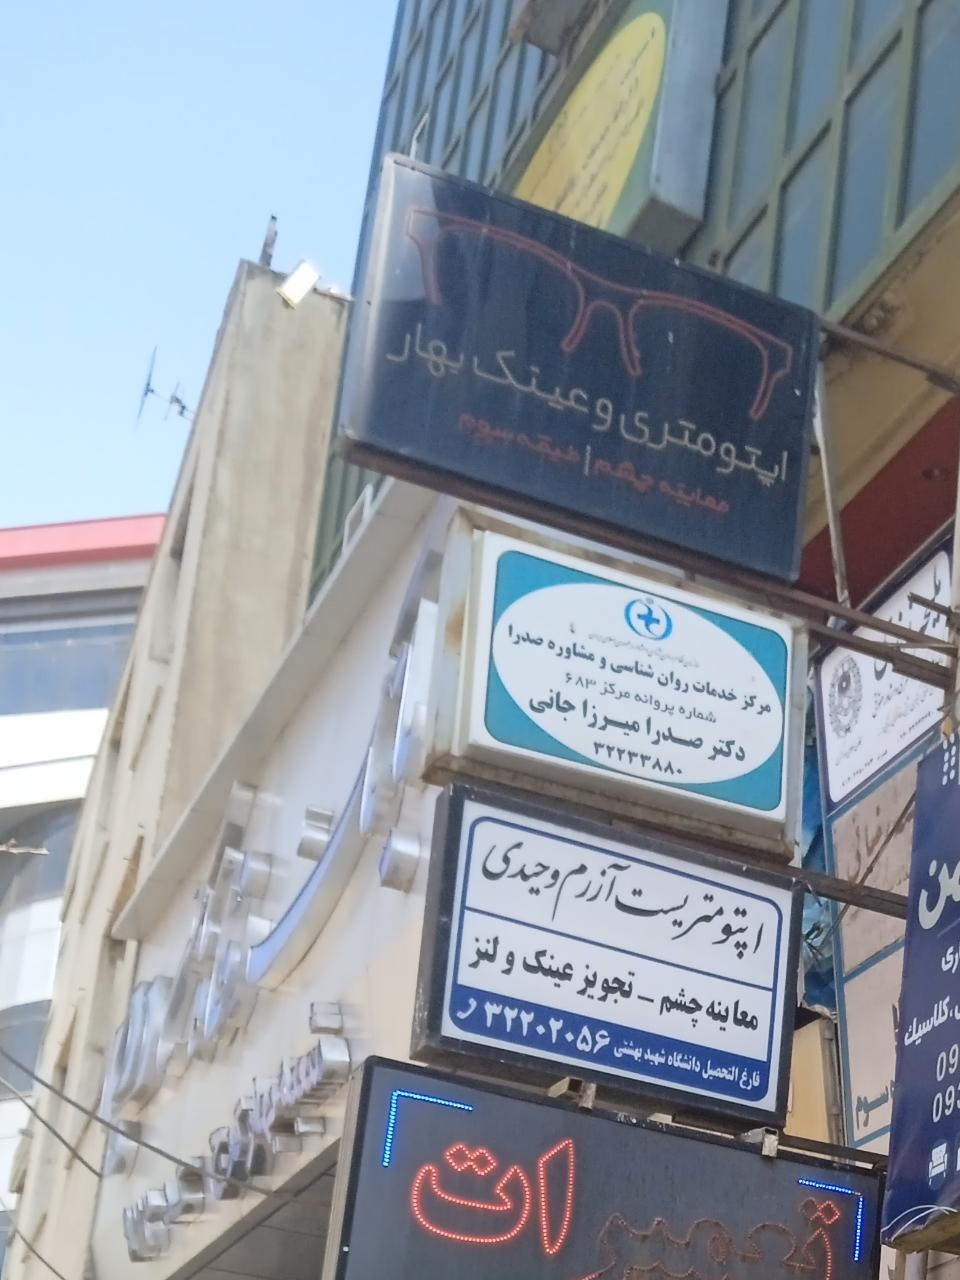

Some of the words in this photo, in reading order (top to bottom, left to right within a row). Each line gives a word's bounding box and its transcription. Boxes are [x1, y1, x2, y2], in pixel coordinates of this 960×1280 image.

[386, 322, 465, 377] بهار
[472, 349, 590, 412] عینک
[592, 397, 613, 431] و
[619, 410, 789, 487] اپتومتری
[508, 624, 545, 646] صدرا
[548, 640, 596, 662] مشاوره
[599, 656, 608, 670] و
[564, 671, 598, 690] ۶۸۳
[600, 682, 632, 700] مرکز
[692, 679, 738, 702] خدمات
[529, 688, 577, 721] جانی
[634, 692, 676, 715] پروانه
[678, 705, 717, 724] شماره
[740, 695, 772, 715] مرکز
[582, 698, 641, 736] میرزا
[646, 716, 704, 749] صدرا
[592, 740, 684, 775] ۳۲۲۳۳۸۸۰
[707, 739, 747, 762] دکتر
[481, 841, 561, 897] وحیدی
[468, 936, 500, 969] لنز
[501, 950, 515, 975] و
[522, 949, 574, 989] عینک
[576, 964, 635, 1004] تجویز
[658, 988, 703, 1028] چشم
[706, 999, 759, 1032] معاینه
[484, 1000, 611, 1055] ۳۲۲۰۲۰۵۶
[613, 1039, 644, 1062] بهشتی
[643, 1046, 667, 1067] شهید
[667, 1052, 701, 1074] دانشگاه
[701, 1058, 738, 1083] التحصیل
[739, 1066, 761, 1090] فارغ
